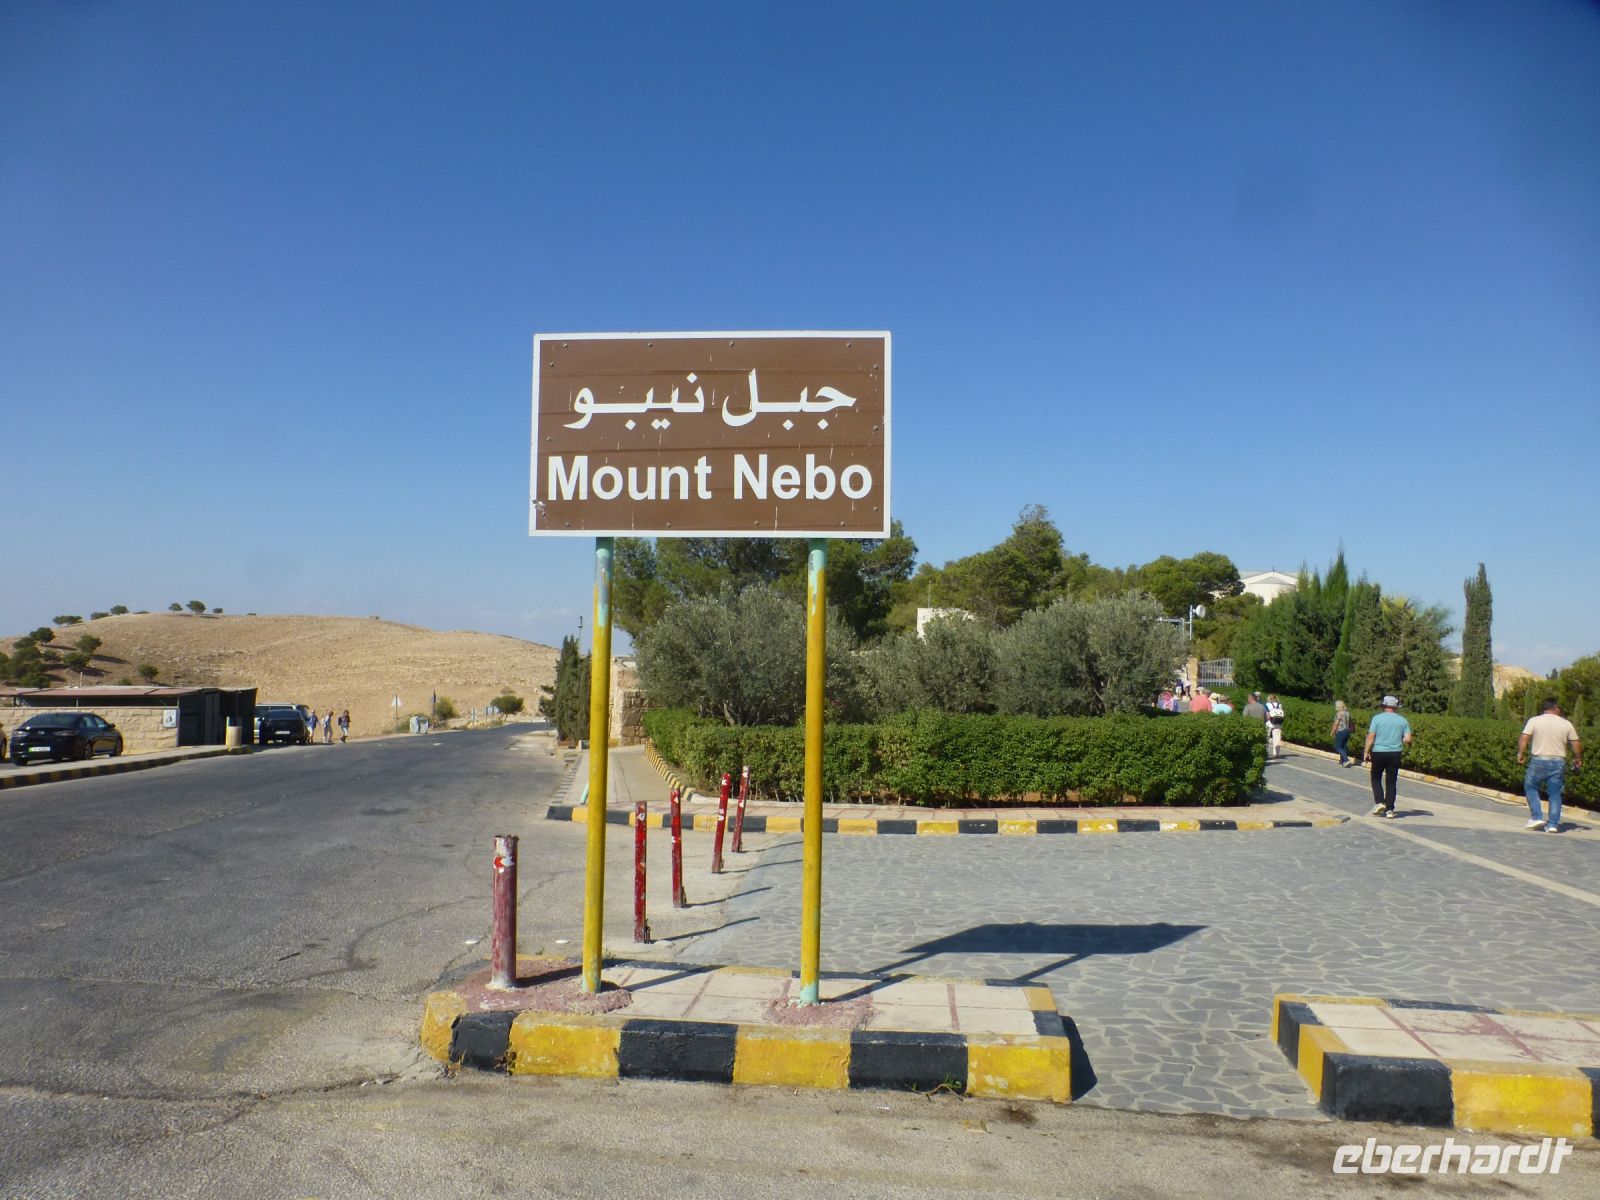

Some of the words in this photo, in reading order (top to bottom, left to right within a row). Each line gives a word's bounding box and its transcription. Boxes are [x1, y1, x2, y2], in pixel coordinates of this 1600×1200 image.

[562, 372, 705, 430] نيبو
[721, 367, 857, 431] جبل
[547, 455, 712, 501] Mount
[733, 453, 873, 500] Nebo
